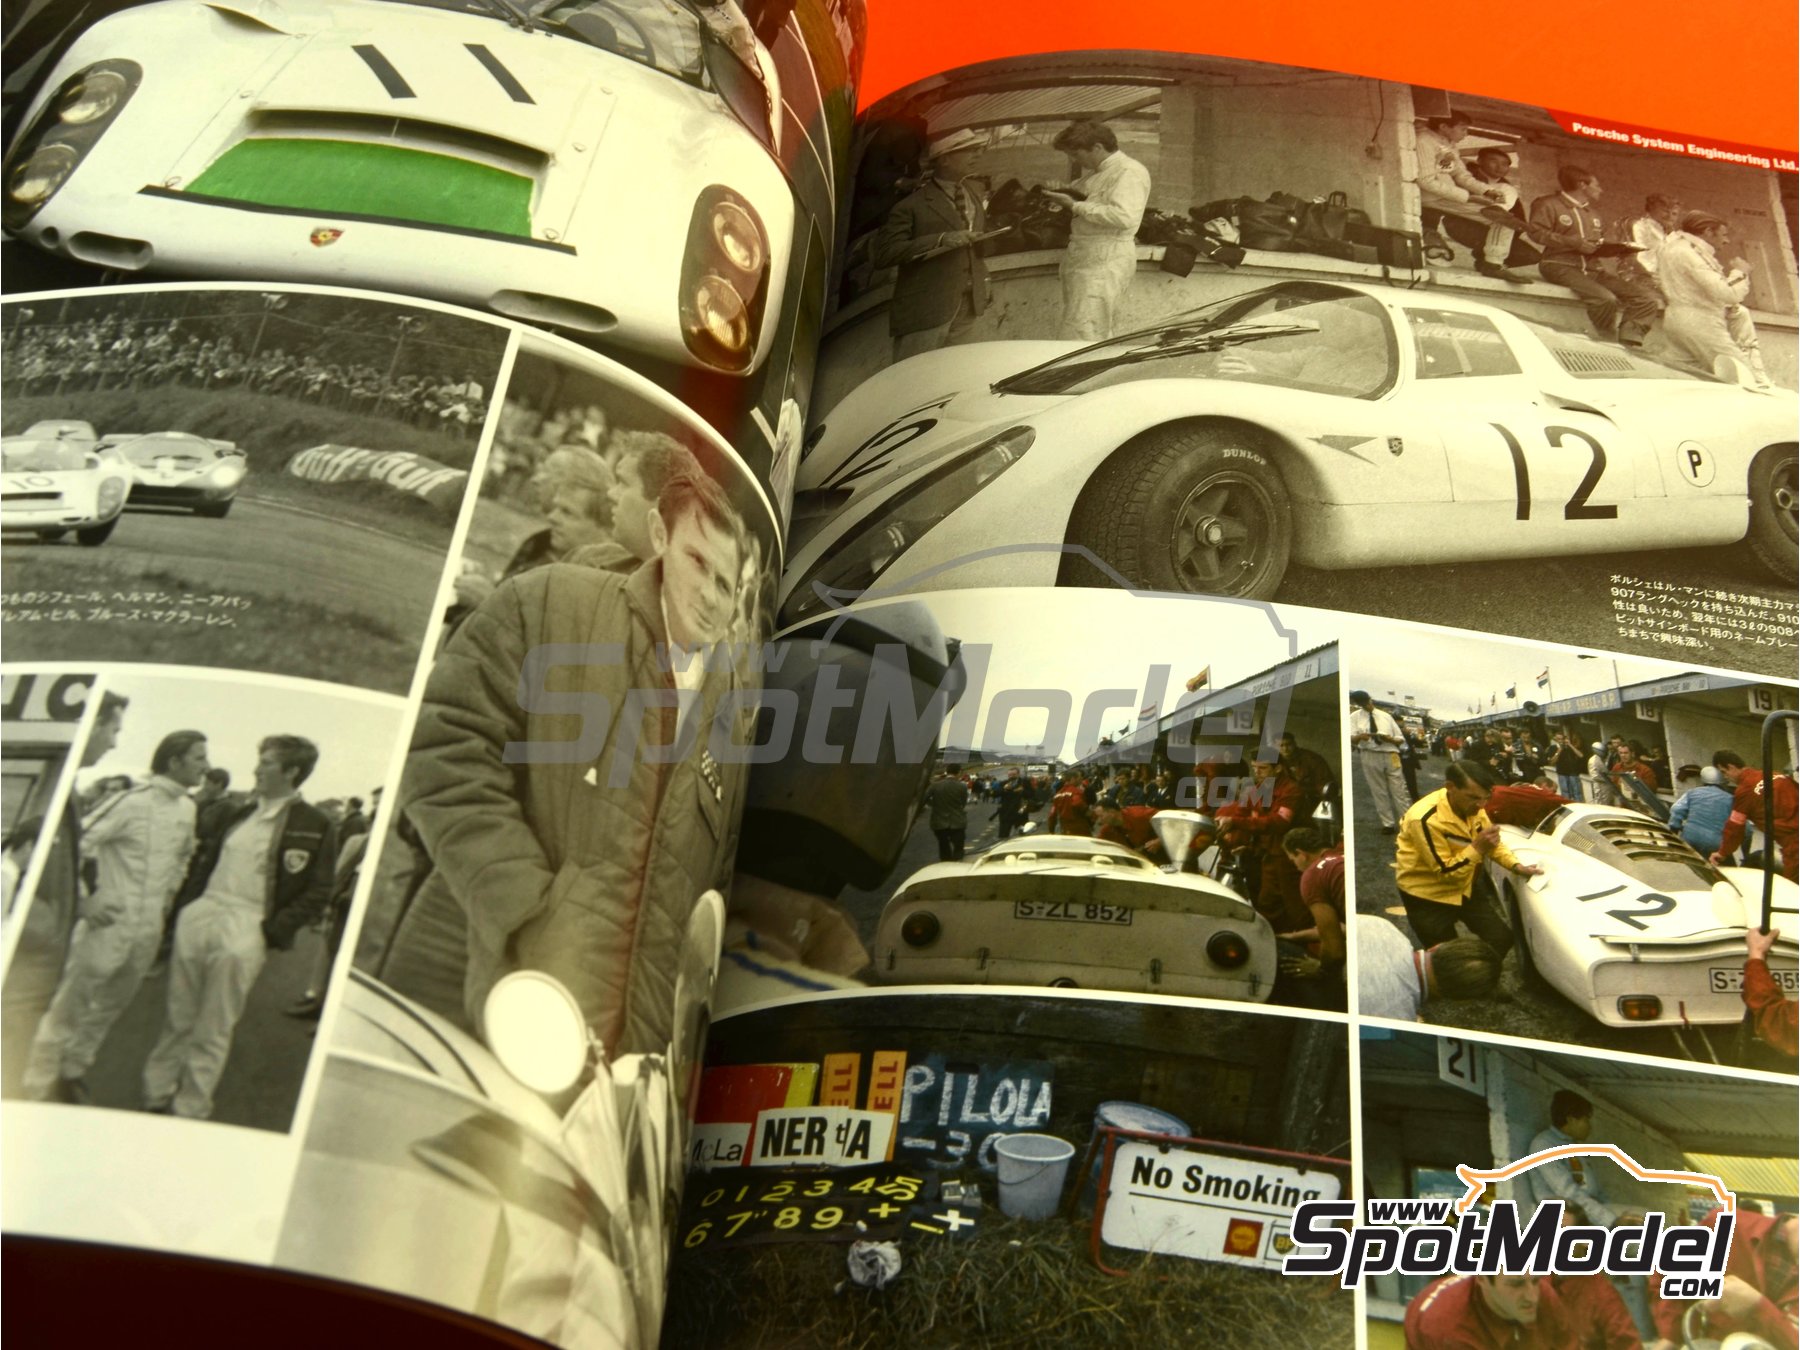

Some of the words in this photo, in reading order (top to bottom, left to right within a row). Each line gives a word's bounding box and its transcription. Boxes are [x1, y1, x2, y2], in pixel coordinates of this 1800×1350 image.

[351, 44, 537, 105] 11
[1572, 122, 1629, 143] Porsche
[1632, 134, 1684, 153] System
[1687, 144, 1770, 169] Engineering
[1773, 158, 1799, 171] Ltd.
[1222, 448, 1267, 466] DUNLOP
[1489, 422, 1618, 521] 12
[1686, 448, 1702, 479] P
[1753, 690, 1773, 711] 19
[1232, 710, 1253, 729] 19
[1085, 904, 1128, 922] 852
[1576, 884, 1677, 931] 12
[1447, 1039, 1477, 1084] 21
[873, 1061, 899, 1110] ELL
[761, 1116, 828, 1158] NER
[802, 1179, 833, 1197] 3
[1130, 1155, 1173, 1190] No
[772, 1206, 802, 1230] 8
[809, 1206, 844, 1230] 9
